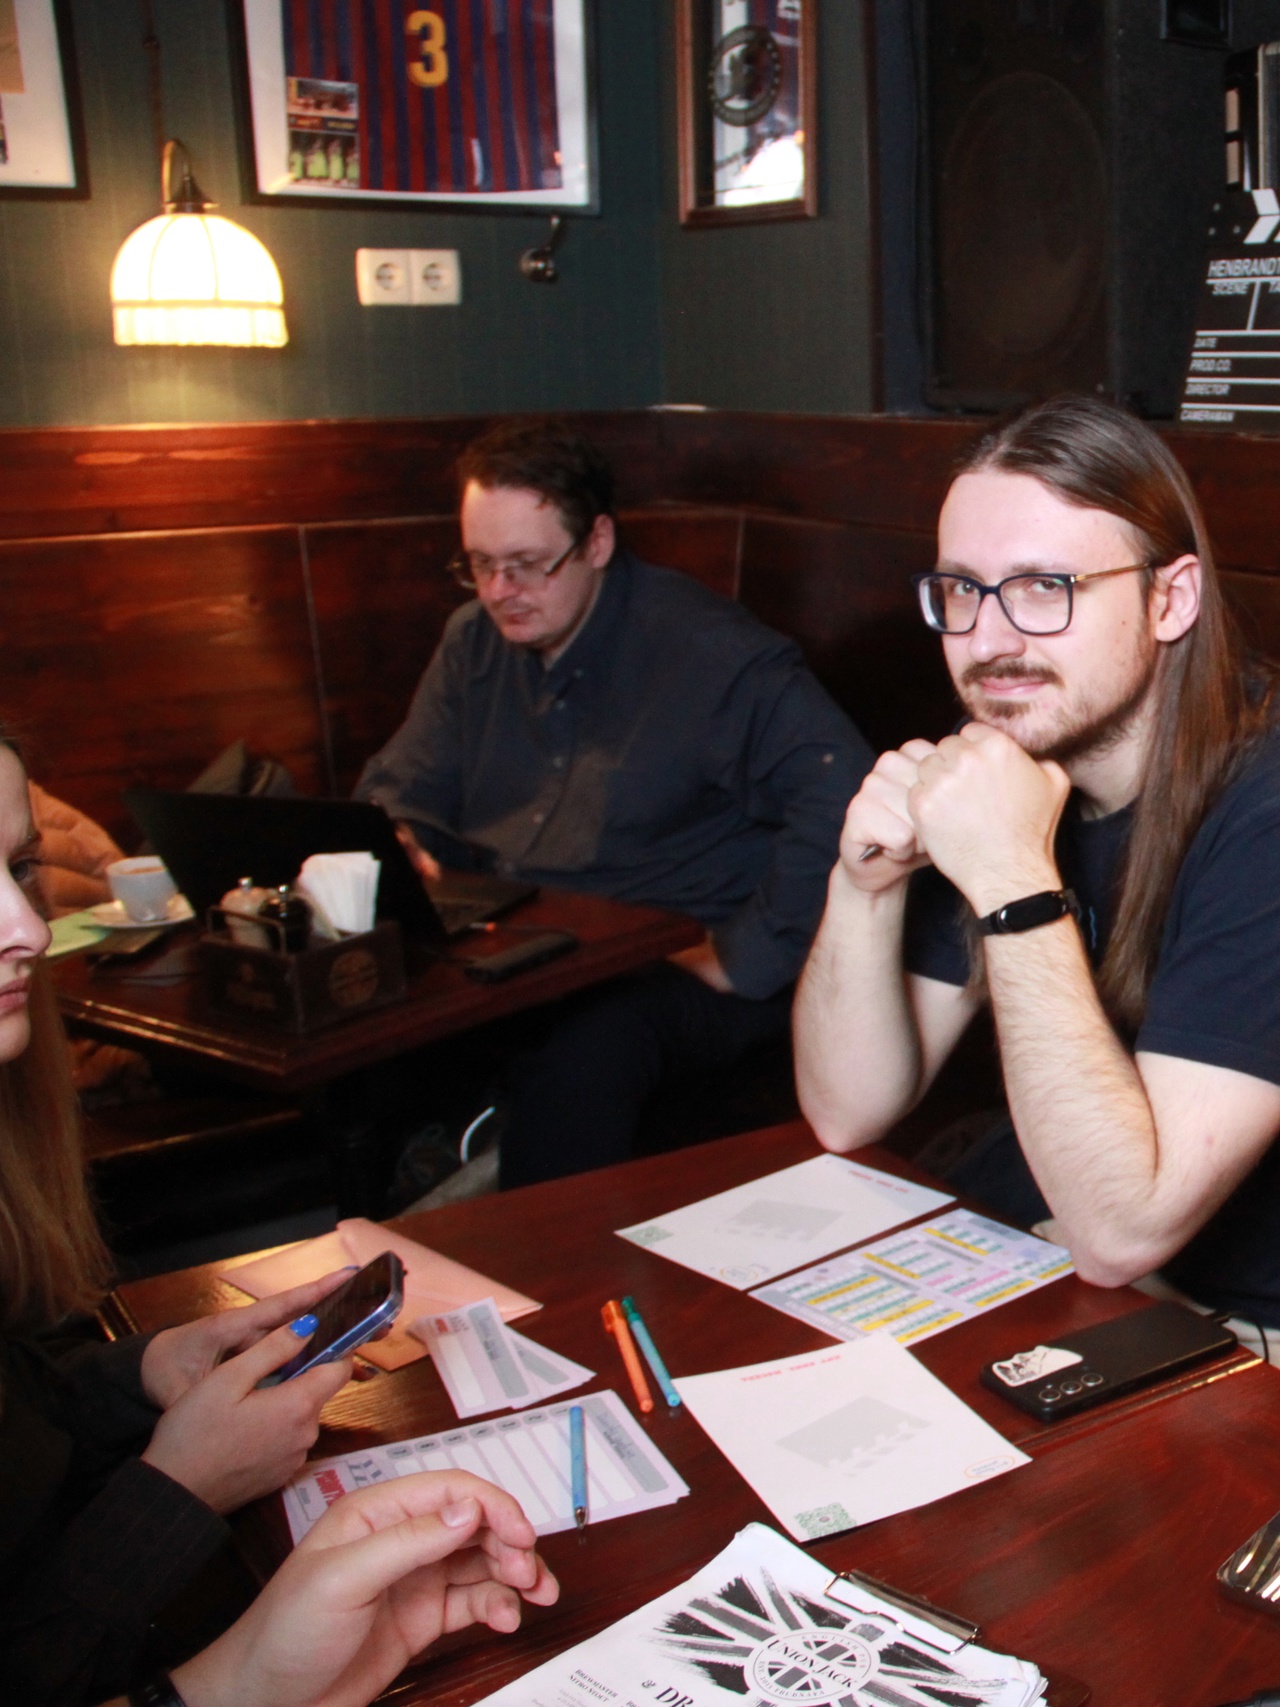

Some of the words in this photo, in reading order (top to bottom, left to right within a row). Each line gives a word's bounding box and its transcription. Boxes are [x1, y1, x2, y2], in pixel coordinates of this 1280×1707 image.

[405, 10, 449, 87] 3
[1212, 281, 1249, 295] SCENE
[1193, 337, 1217, 349] DATE
[1184, 383, 1230, 396] DIRECTOR
[1180, 409, 1235, 422] CAMERAMAN
[801, 1633, 860, 1651] ENGLISH
[767, 1639, 819, 1668] UNION
[812, 1664, 858, 1688] JACK
[569, 1673, 588, 1691] NITRO
[588, 1687, 610, 1703] STOUT
[575, 1668, 618, 1698] BREWMASTER
[641, 1678, 656, 1689] &
[774, 1688, 825, 1698] TRUBNAYA
